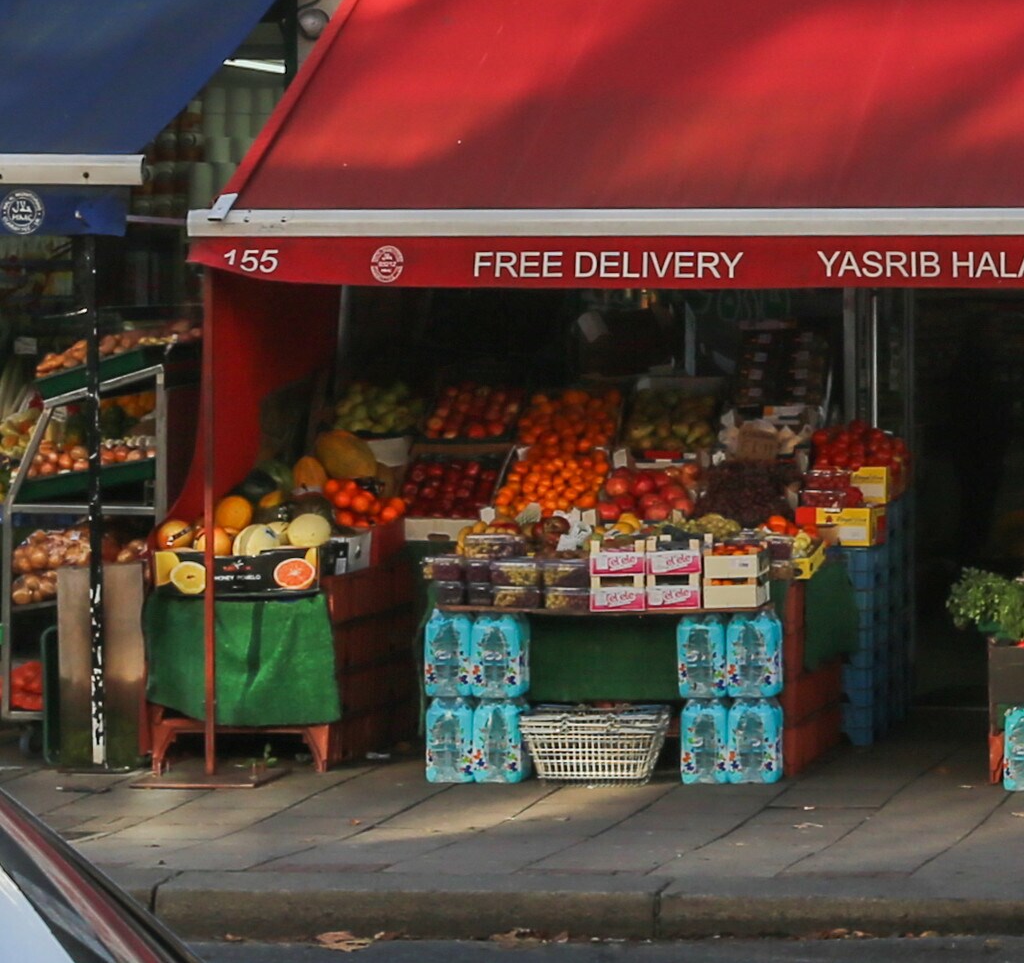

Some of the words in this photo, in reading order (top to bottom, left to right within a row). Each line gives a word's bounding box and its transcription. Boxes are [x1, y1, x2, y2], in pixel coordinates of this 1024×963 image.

[222, 248, 279, 274] 155
[473, 251, 563, 279] FREE
[574, 251, 744, 279] DELIVERY
[817, 251, 941, 279] YASRIB
